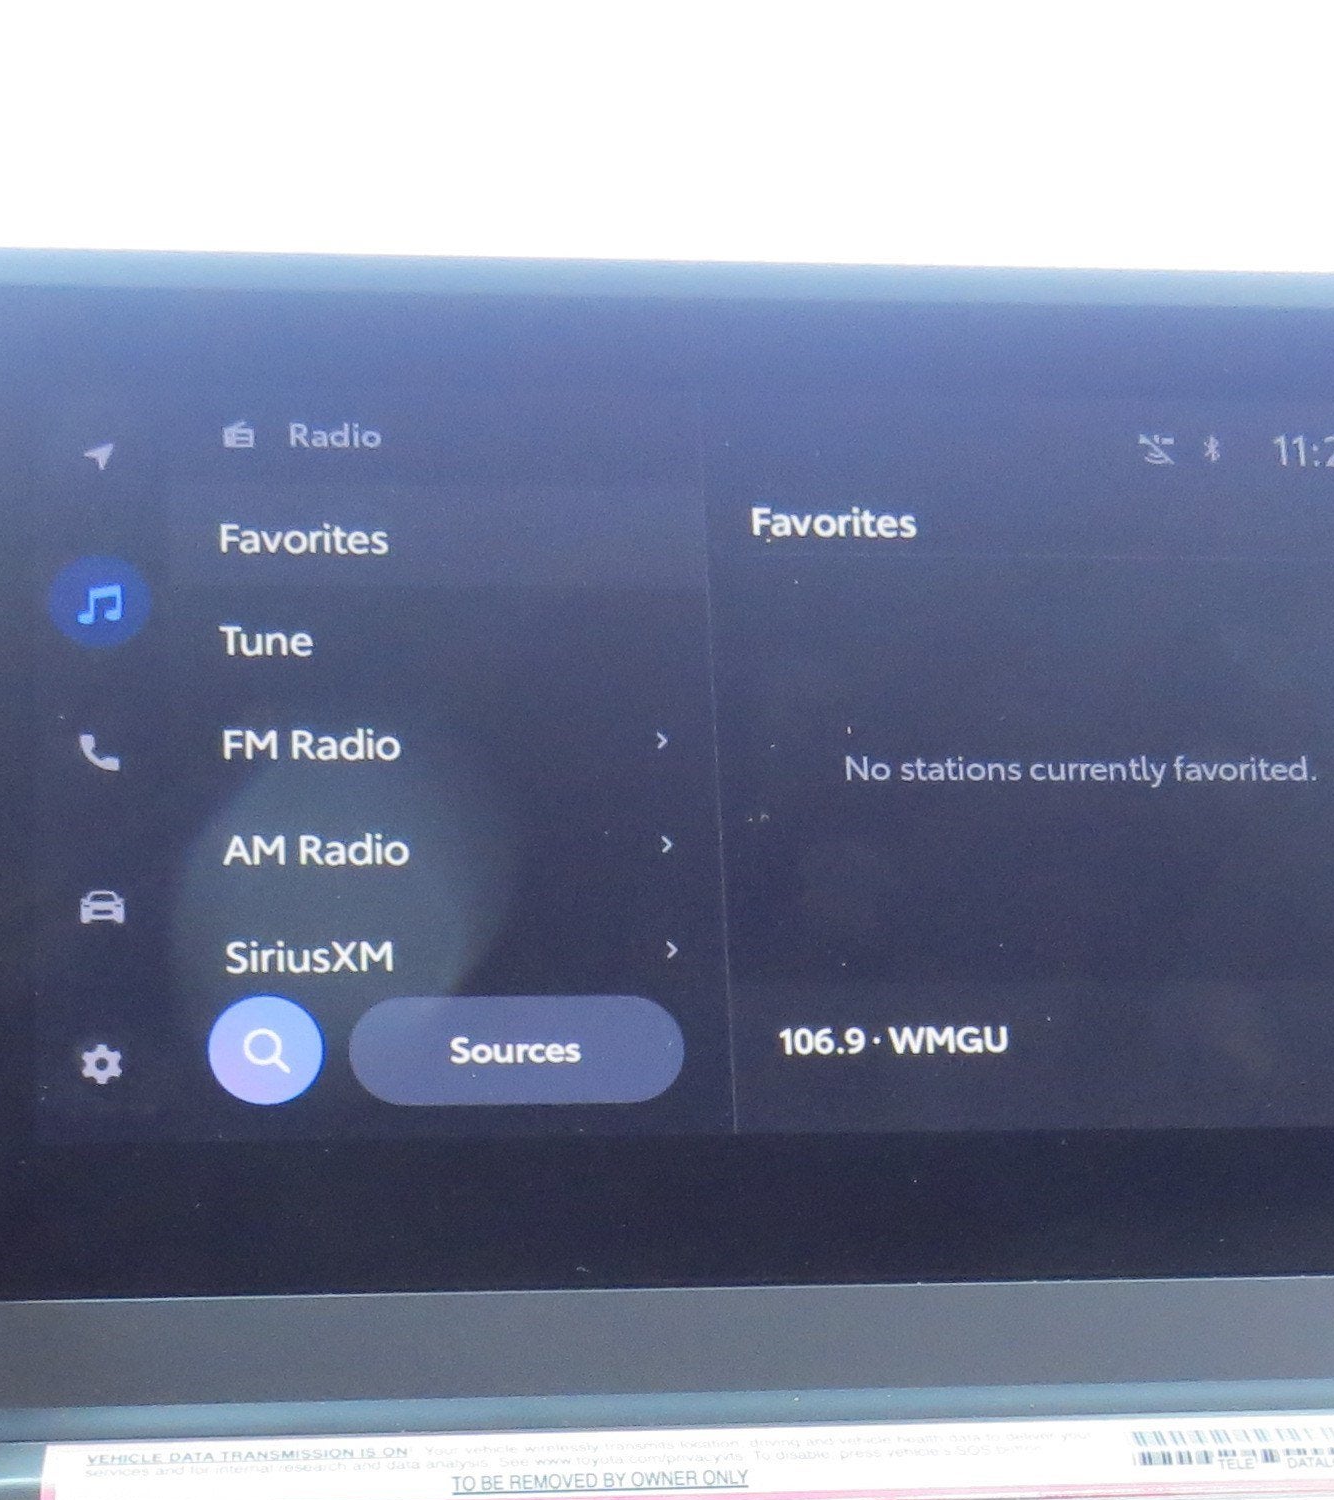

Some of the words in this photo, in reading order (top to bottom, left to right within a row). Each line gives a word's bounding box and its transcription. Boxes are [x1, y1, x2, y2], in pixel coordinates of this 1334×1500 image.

[289, 422, 382, 449] Radio
[751, 506, 917, 538] Favorites
[220, 522, 389, 555] Favorites
[219, 625, 314, 657] Tune
[223, 729, 278, 760] FM
[291, 727, 401, 761] Radio
[845, 755, 891, 781] No
[900, 755, 1022, 781] stations
[1029, 755, 1167, 789] currently
[1173, 755, 1317, 782] favorited.
[223, 834, 286, 866] AM
[299, 832, 410, 866] Radio
[226, 940, 393, 974] SiriusXM
[450, 1036, 582, 1064] Sources
[888, 1025, 1008, 1054] WMGU
[86, 1453, 162, 1465] VEHICLE
[169, 1452, 214, 1463] DATA
[221, 1448, 354, 1462] TRANSMISSION
[360, 1447, 376, 1458] IS
[1217, 1457, 1255, 1470] TELE
[451, 1475, 476, 1491] TO
[480, 1474, 505, 1491] BE
[509, 1472, 598, 1490] REMOVED
[602, 1471, 627, 1488] BY
[631, 1469, 698, 1488] OWNER
[702, 1468, 750, 1486] ONLY
